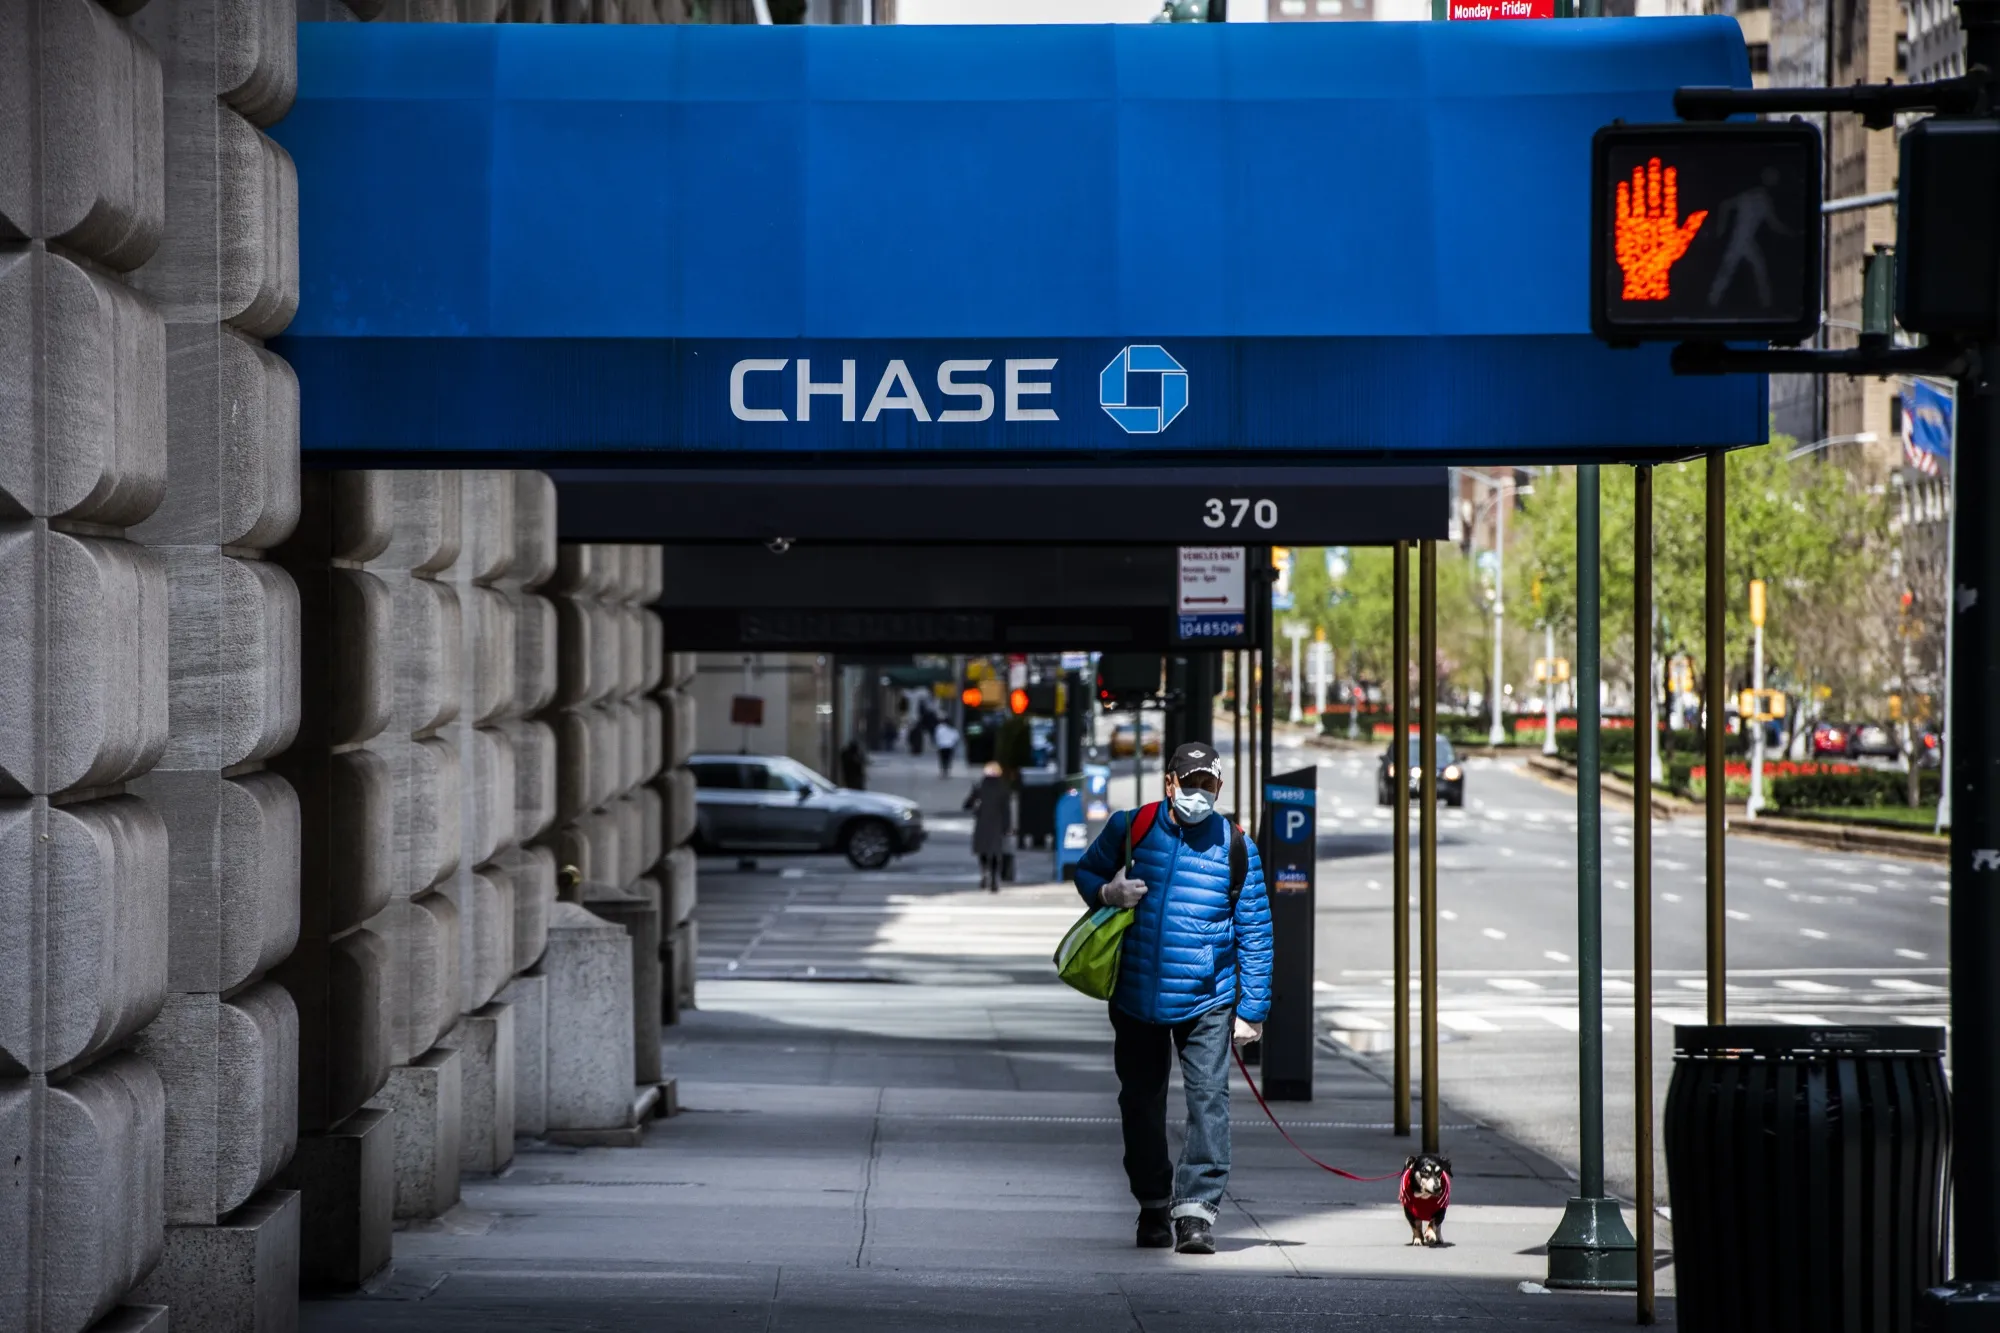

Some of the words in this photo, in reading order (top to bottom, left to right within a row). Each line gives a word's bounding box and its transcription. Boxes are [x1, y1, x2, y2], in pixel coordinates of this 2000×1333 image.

[1454, 3, 1492, 20] Monday
[1501, 1, 1532, 17] Friday
[729, 358, 1060, 422] CHASE
[1202, 497, 1278, 529] 370
[1220, 551, 1240, 561] ONLY
[1180, 621, 1230, 637] 104850
[1286, 810, 1305, 839] P
